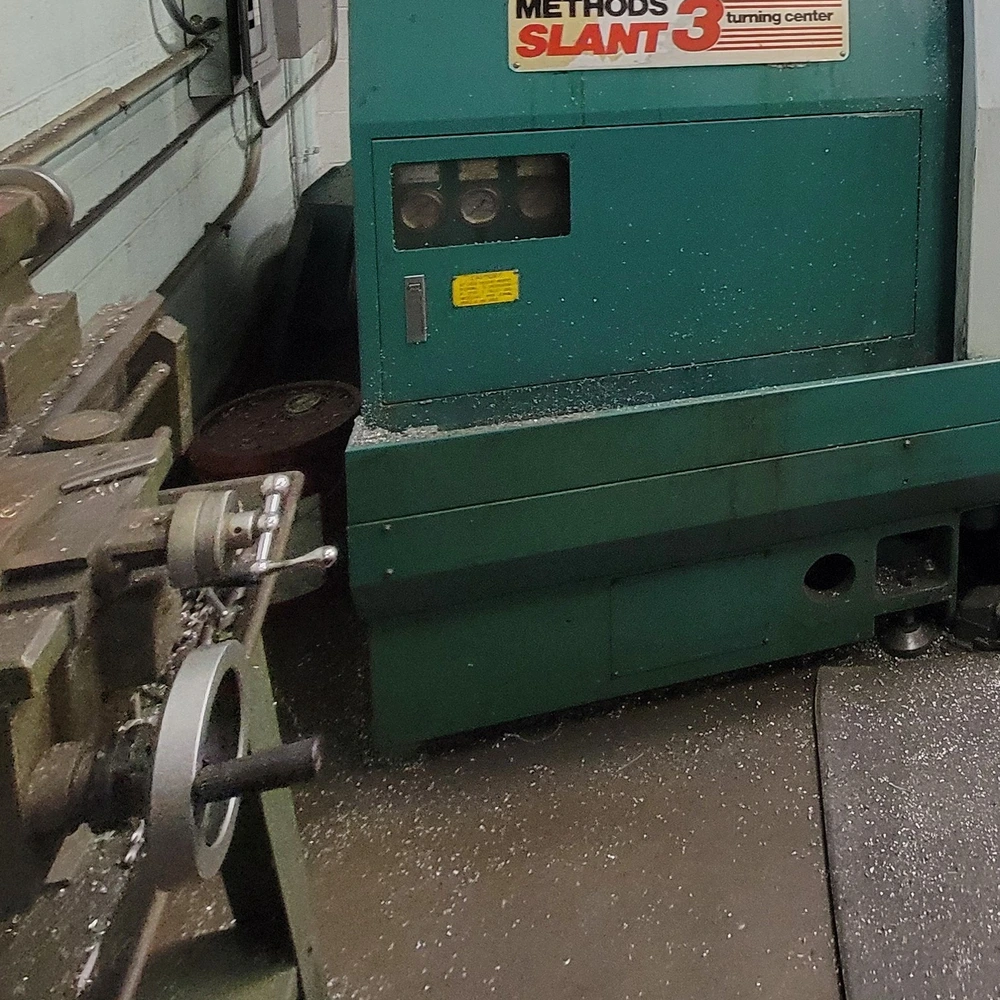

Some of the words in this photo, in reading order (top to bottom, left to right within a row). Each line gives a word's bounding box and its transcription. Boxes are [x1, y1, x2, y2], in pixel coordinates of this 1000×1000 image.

[726, 11, 782, 25] turning
[784, 10, 833, 23] center
[516, 22, 669, 57] SLANT
